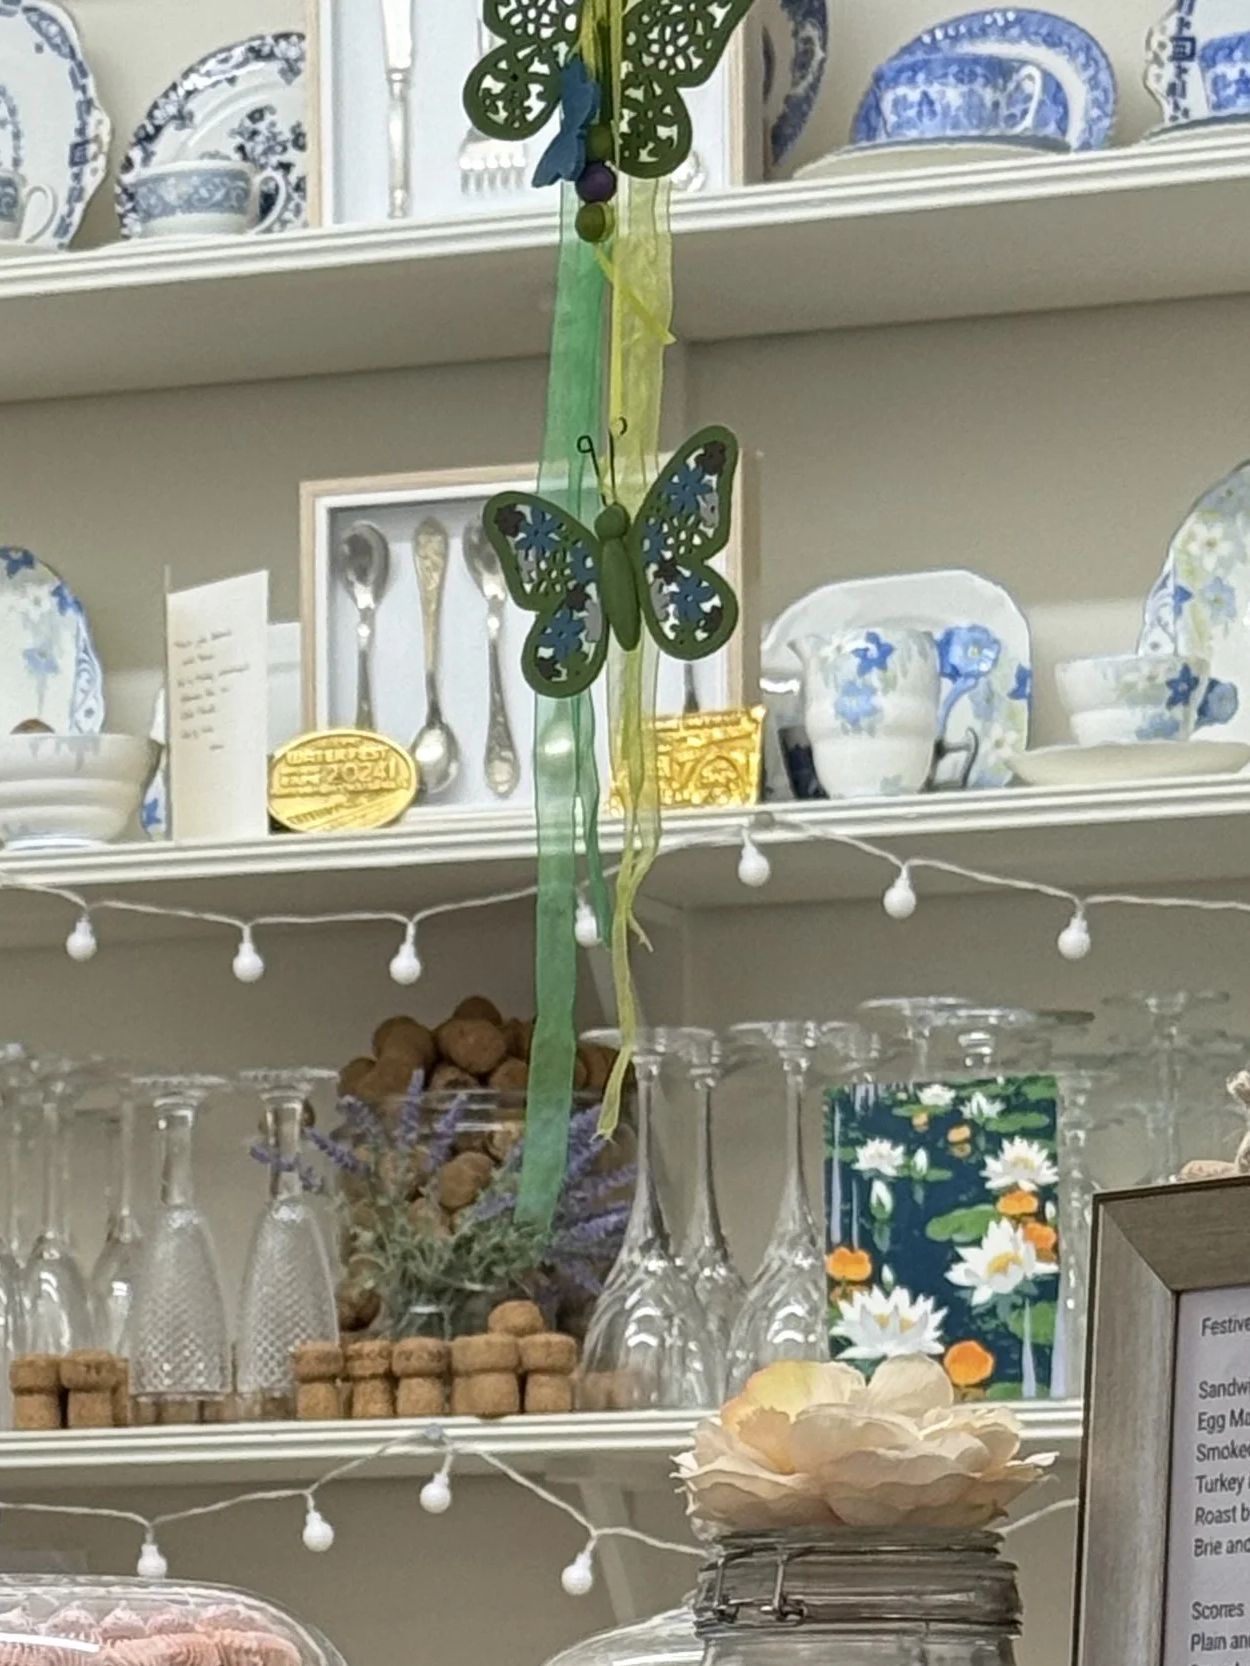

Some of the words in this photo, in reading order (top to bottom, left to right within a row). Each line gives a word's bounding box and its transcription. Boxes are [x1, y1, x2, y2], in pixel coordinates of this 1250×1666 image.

[1197, 1411, 1226, 1435] Egg
[1194, 1472, 1245, 1497] Turkey
[1194, 1506, 1237, 1525] Roast
[1193, 1537, 1222, 1558] Brie
[1191, 1601, 1244, 1621] Scones
[1190, 1632, 1227, 1652] Plain
[1229, 1634, 1250, 1650] an
